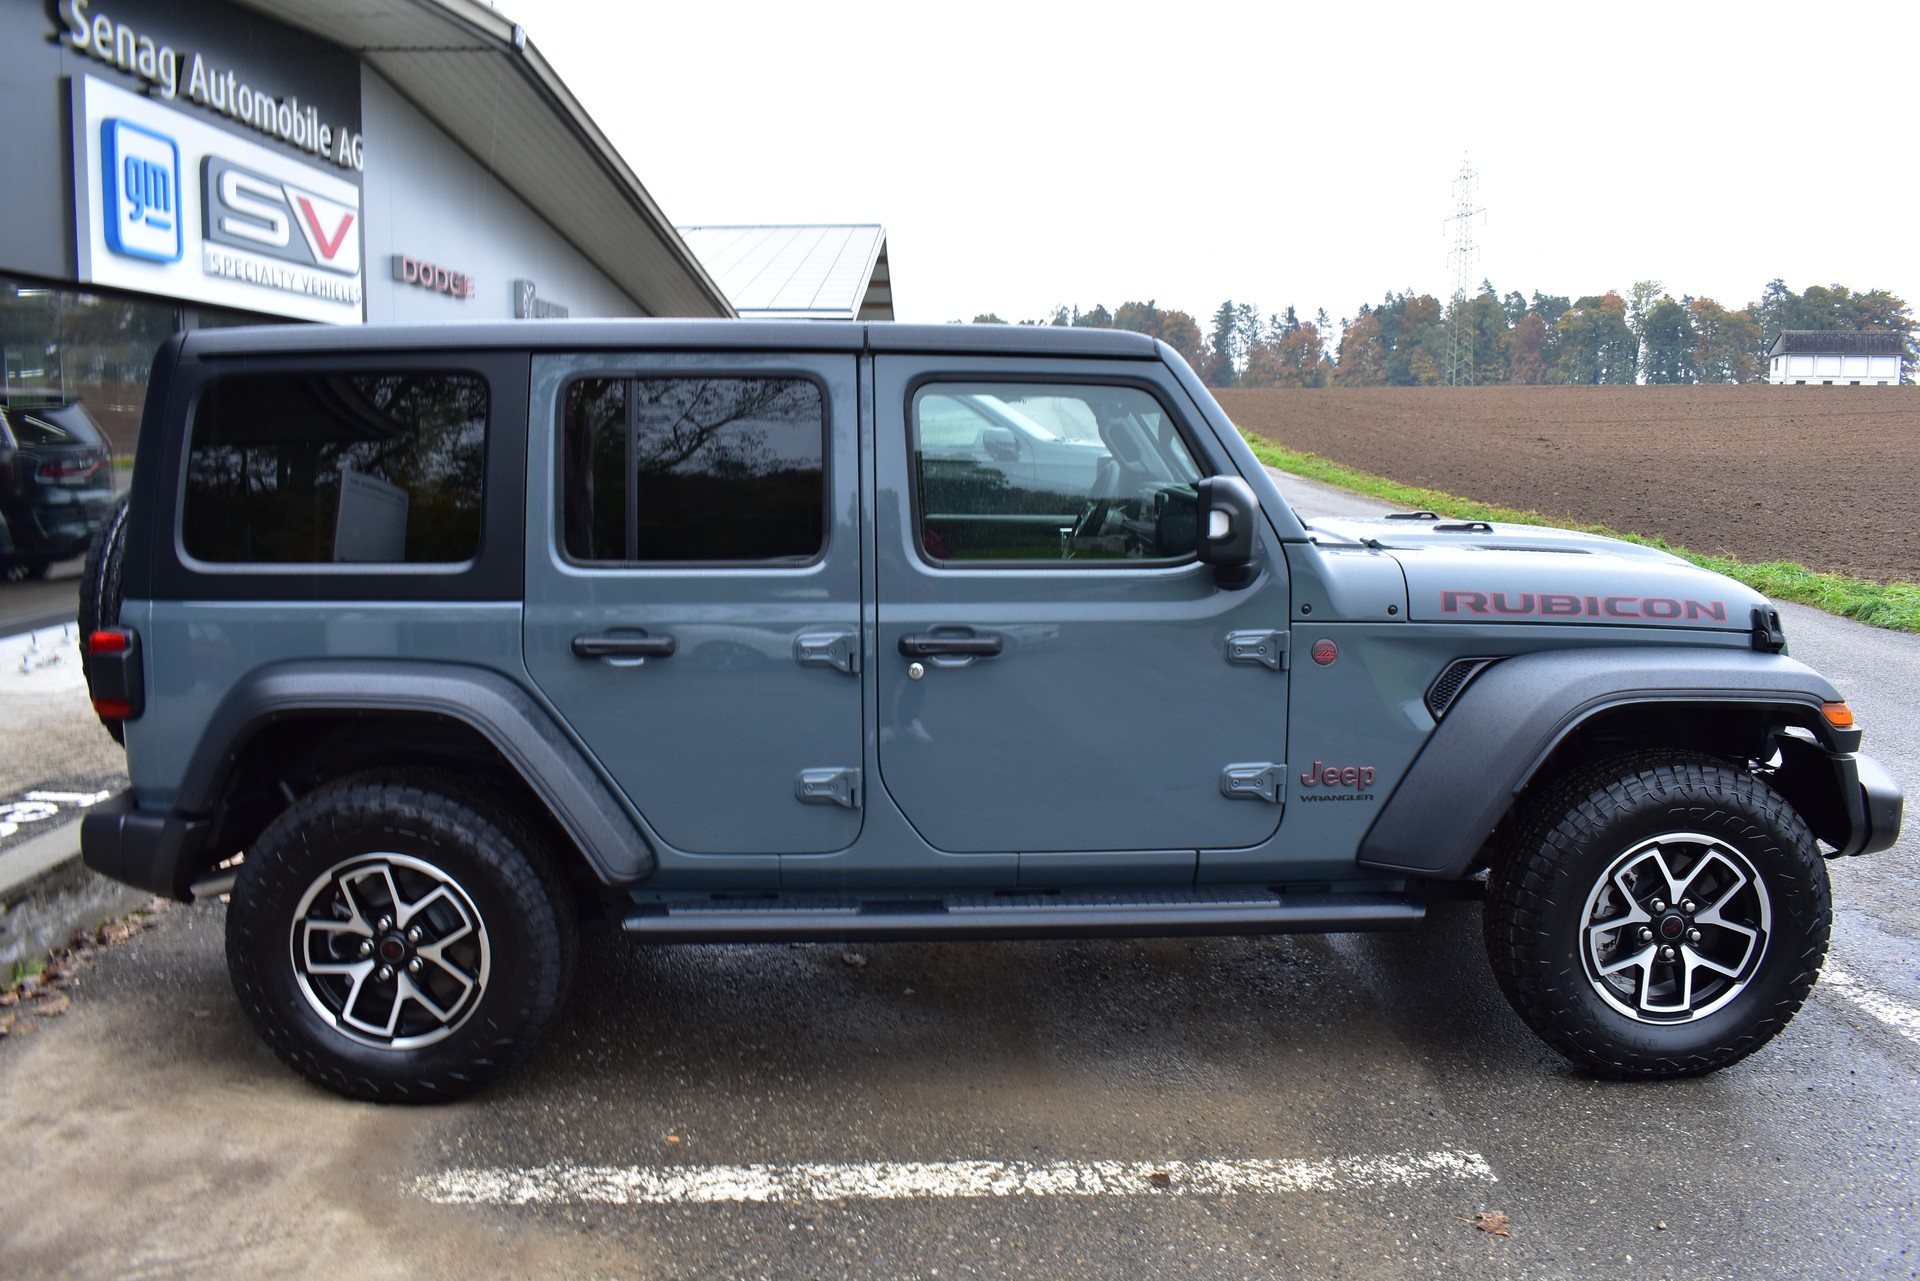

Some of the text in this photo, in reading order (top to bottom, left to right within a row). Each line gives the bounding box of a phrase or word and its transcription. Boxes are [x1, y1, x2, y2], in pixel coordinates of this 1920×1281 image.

[71, 0, 364, 172] Senag Automobile AG
[124, 154, 171, 231] gm
[212, 254, 361, 305] SPECIALTY VEHICLES
[402, 255, 475, 299] DODGE
[1440, 590, 1728, 622] RUBICON
[1301, 760, 1377, 791] Jeep
[1300, 793, 1374, 803] WRANGLER
